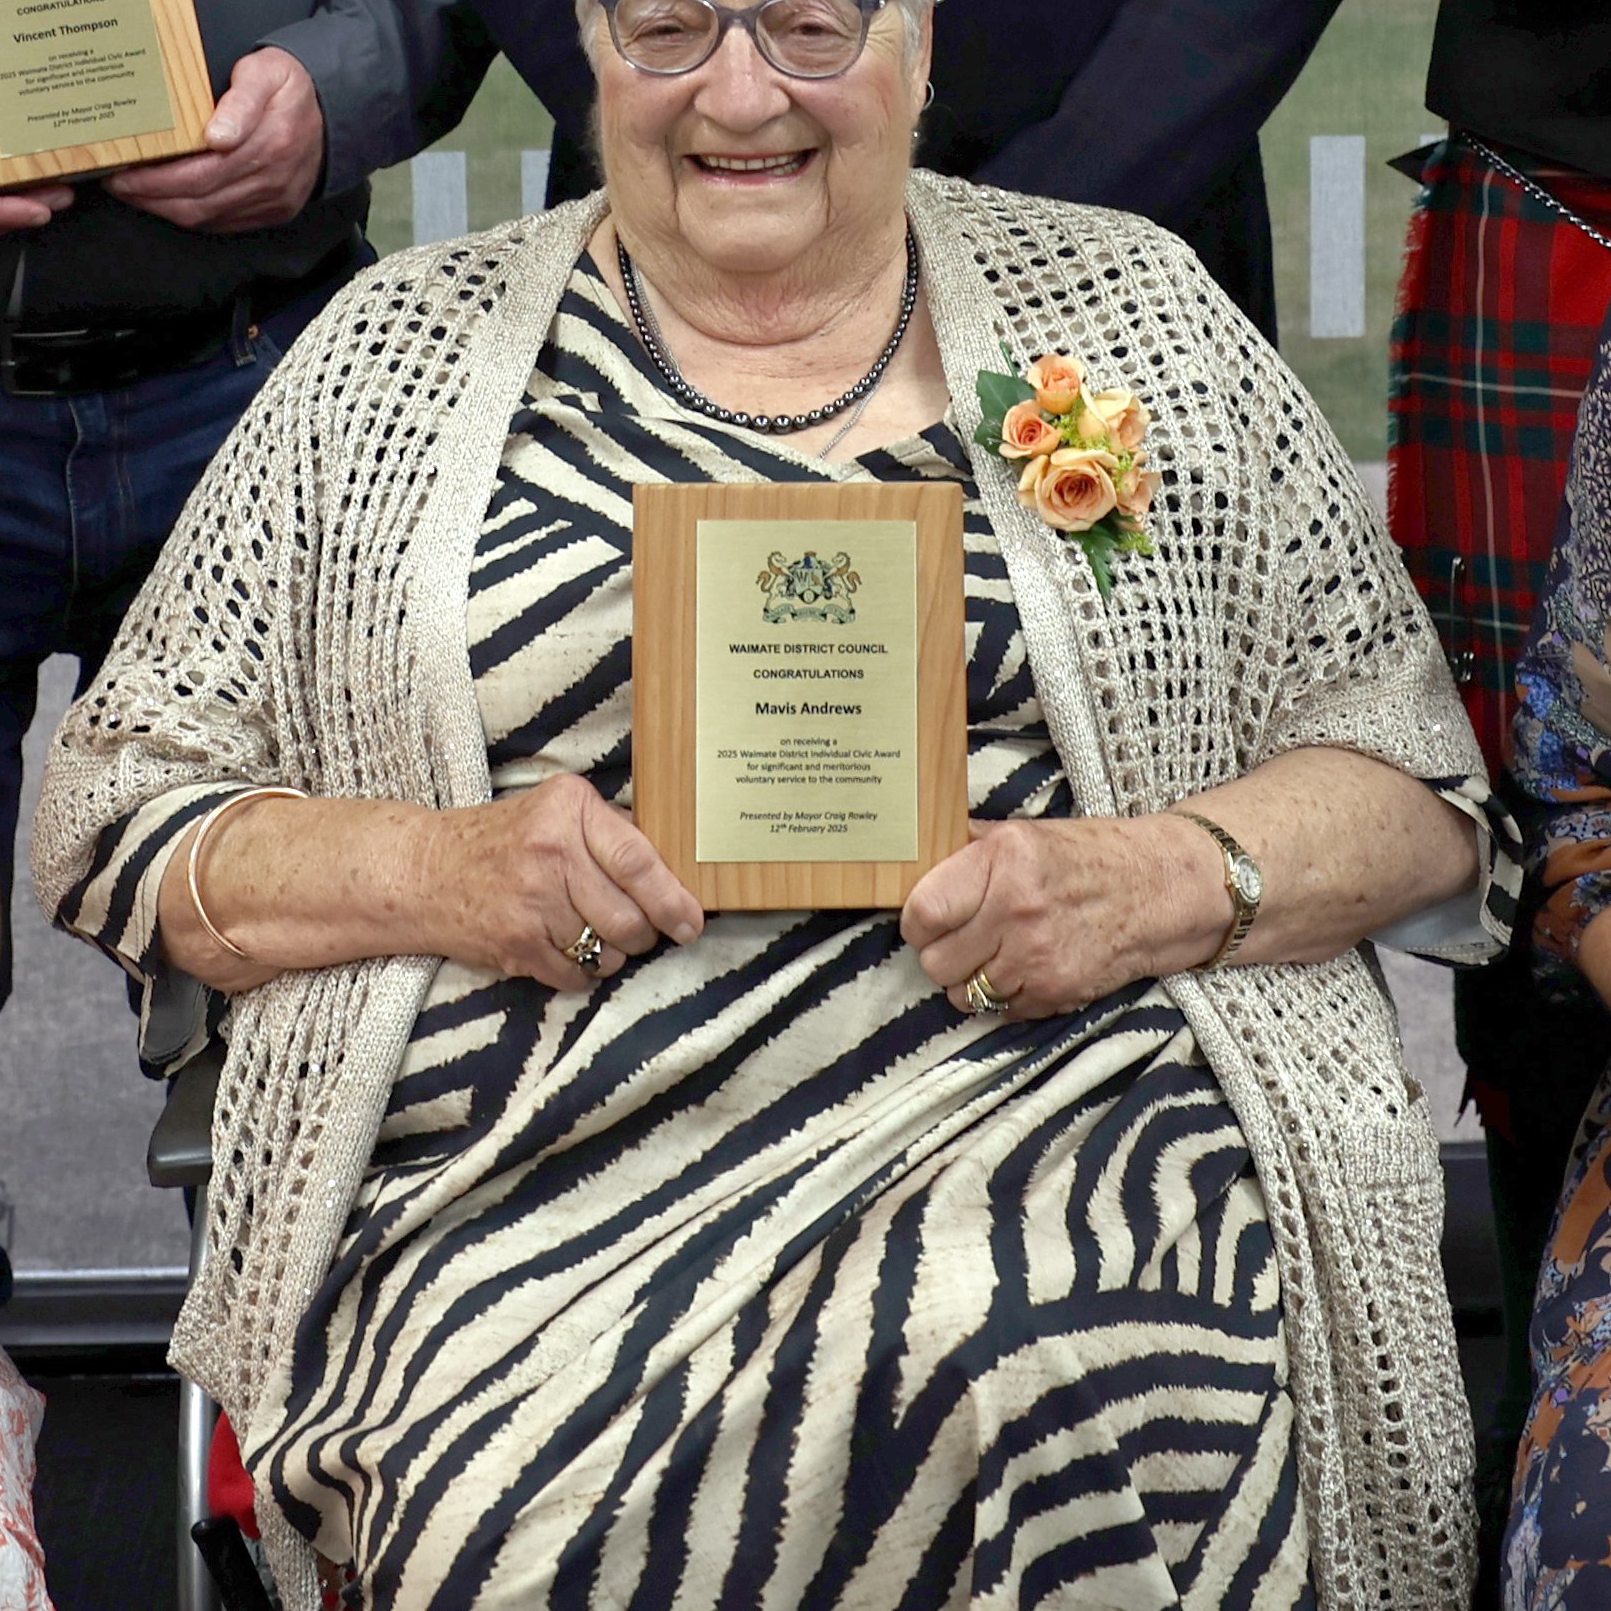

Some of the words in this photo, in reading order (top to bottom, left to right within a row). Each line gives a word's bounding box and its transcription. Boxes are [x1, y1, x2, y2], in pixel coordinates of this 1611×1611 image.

[13, 28, 57, 43] Vincent
[58, 19, 118, 36] Thompson
[729, 644, 780, 654] WAIMATE
[784, 644, 835, 654] DISTRICT
[837, 644, 888, 654] COUNCIL
[753, 669, 864, 679] CONGRATULATIONS
[755, 702, 797, 715] Mavis
[800, 701, 862, 715] Andrews
[793, 737, 831, 748] receiving
[717, 750, 738, 759] 2025
[739, 750, 777, 758] Waimate
[779, 750, 808, 758] District
[810, 750, 851, 758] Individual
[852, 750, 872, 758] Civic
[874, 750, 901, 758] Award
[746, 762, 759, 771] for
[761, 762, 803, 772] significant
[805, 762, 821, 771] and
[822, 762, 871, 771] meritorious
[735, 775, 776, 785] voluntary
[777, 775, 806, 784] service
[819, 775, 833, 783] the
[835, 776, 882, 784] community
[740, 812, 782, 820] Presented
[783, 812, 793, 821] by
[795, 812, 822, 821] Mayor
[824, 811, 846, 822] Craig
[848, 812, 877, 821] Rowley
[788, 824, 826, 834] February
[827, 824, 848, 833] 2025
